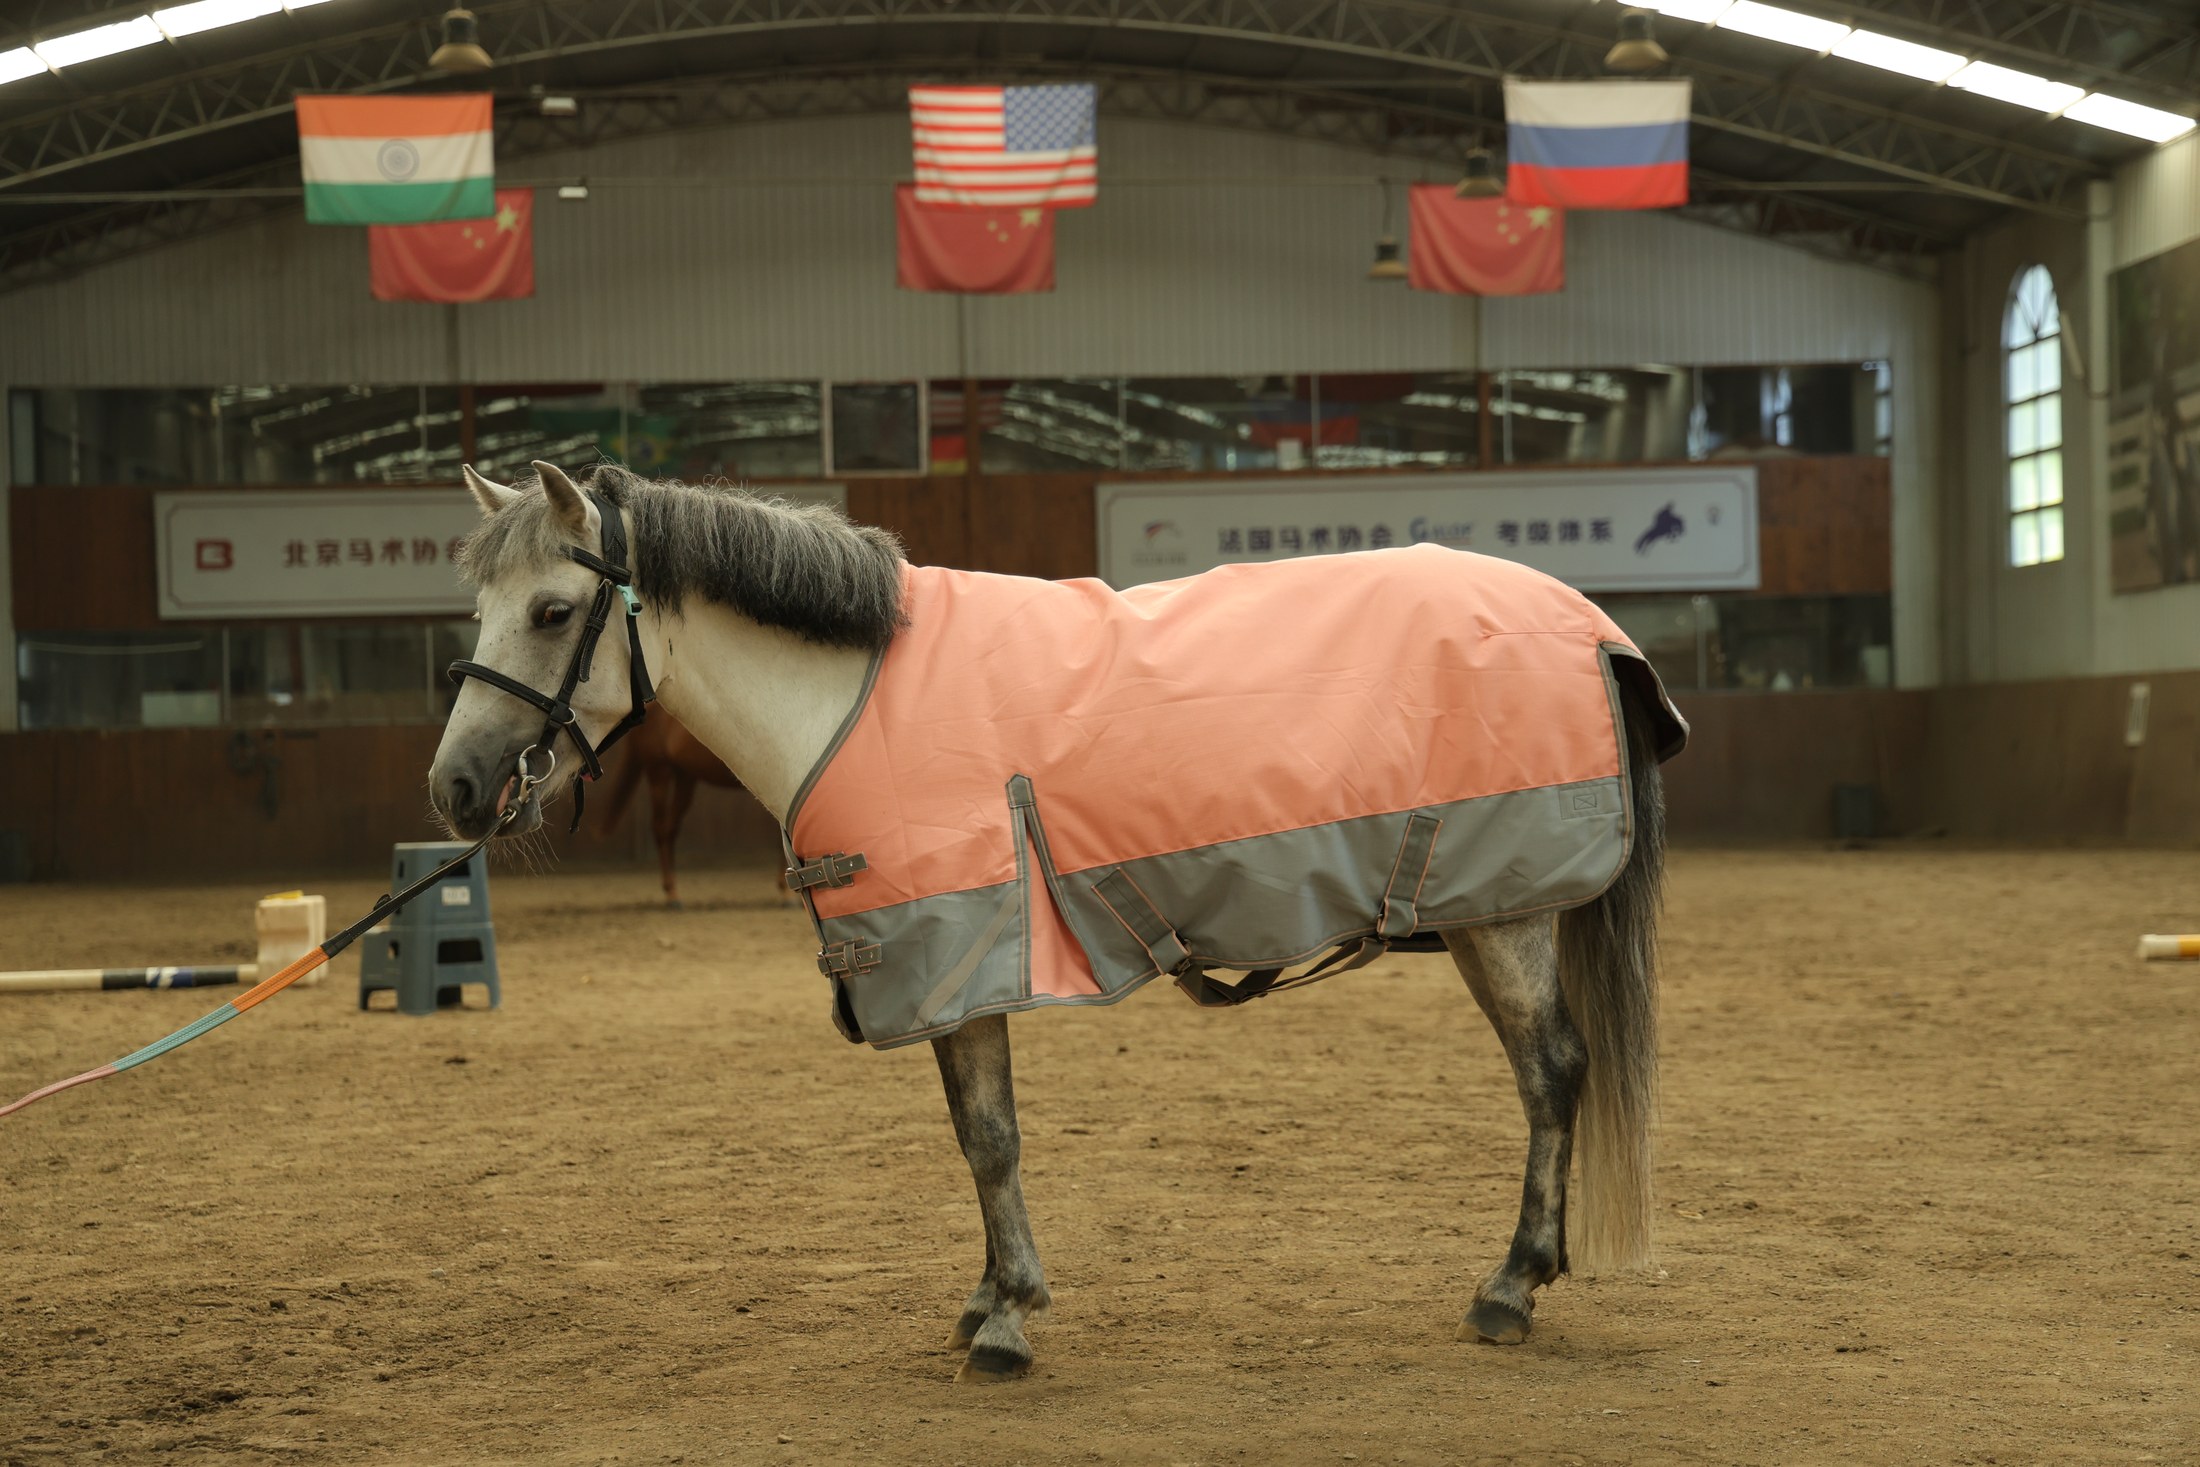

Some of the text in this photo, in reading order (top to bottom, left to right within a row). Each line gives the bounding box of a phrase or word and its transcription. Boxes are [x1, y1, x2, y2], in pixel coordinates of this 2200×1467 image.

[1218, 524, 1394, 555] 法国马术协会
